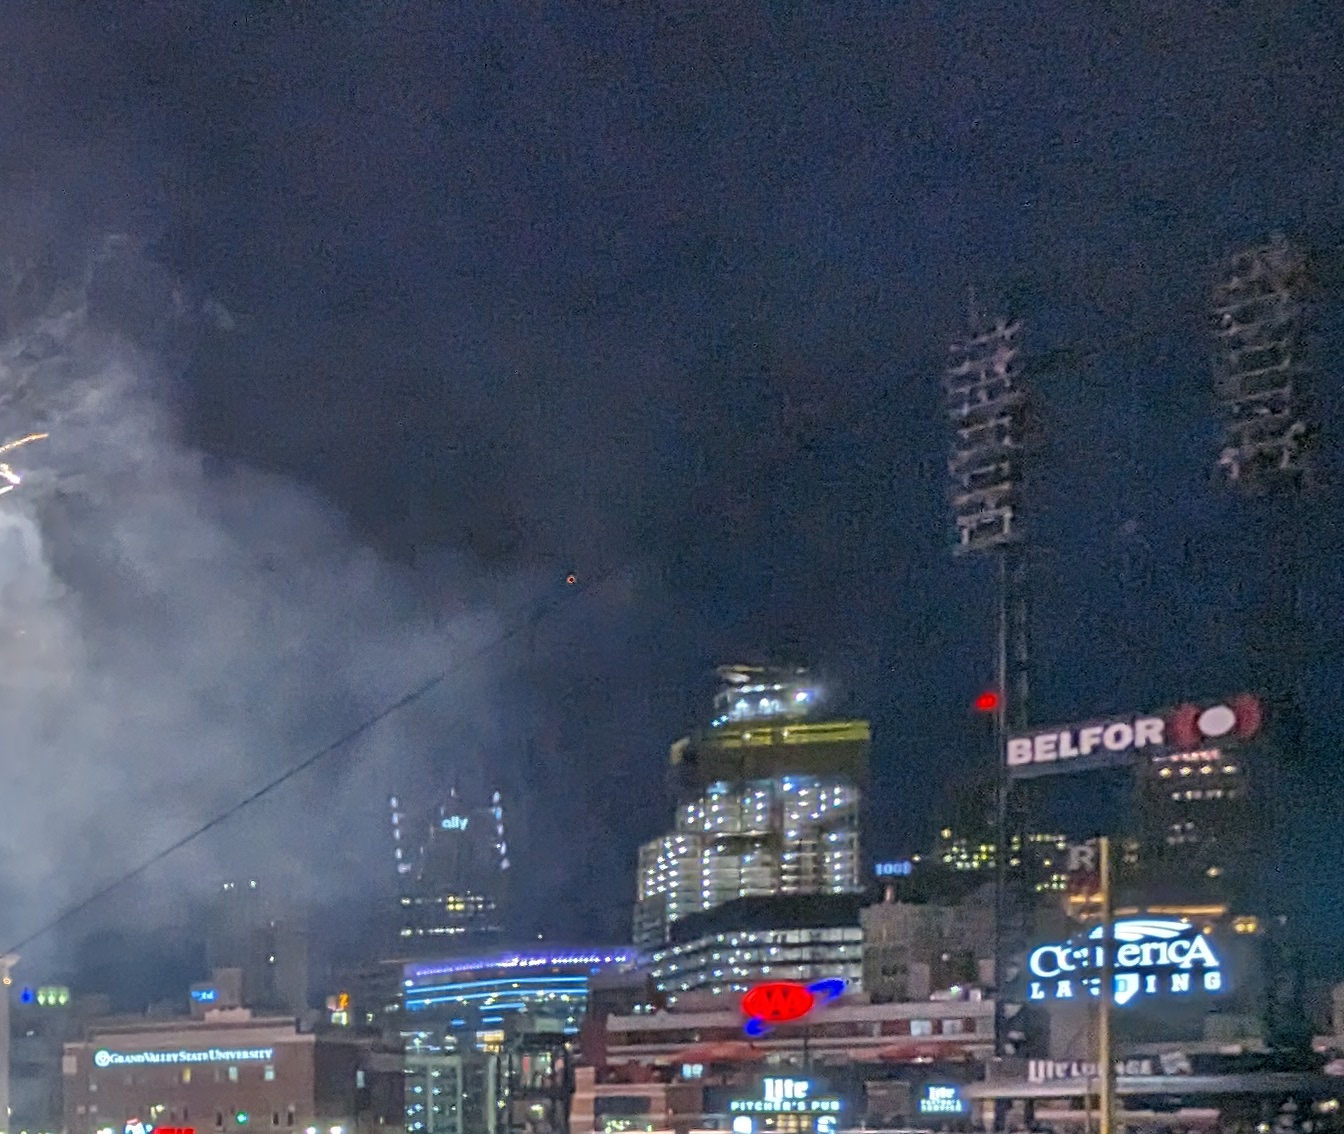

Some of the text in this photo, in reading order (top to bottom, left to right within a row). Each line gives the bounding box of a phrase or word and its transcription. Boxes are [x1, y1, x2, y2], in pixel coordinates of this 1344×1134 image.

[1007, 718, 1165, 766] BELFOR
[441, 816, 468, 830] ally
[811, 1101, 840, 1111] PUB
